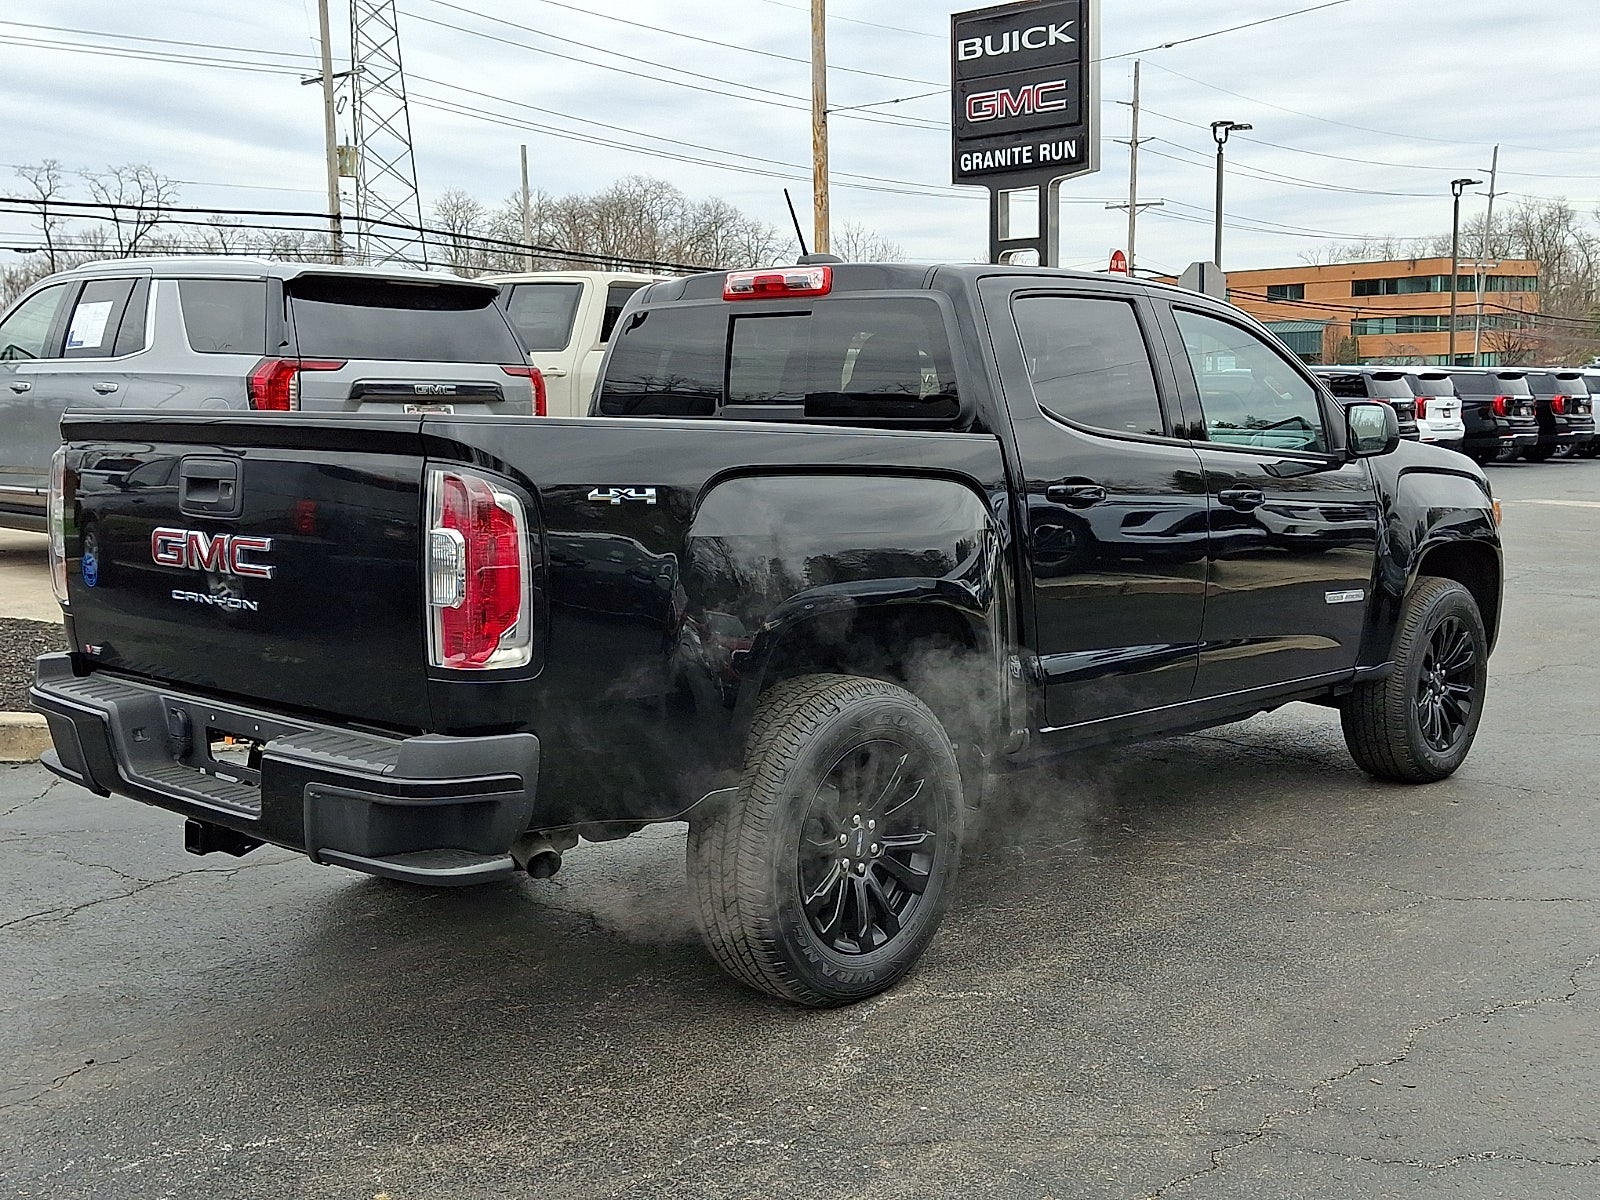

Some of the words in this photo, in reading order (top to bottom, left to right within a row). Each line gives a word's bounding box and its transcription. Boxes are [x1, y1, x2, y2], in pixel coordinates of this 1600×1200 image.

[957, 20, 1076, 61] BUICK
[966, 79, 1068, 122] GMC
[960, 145, 1033, 171] GRANITE
[1039, 139, 1077, 162] RUN
[414, 384, 457, 395] GMC
[151, 526, 277, 580] GMC
[171, 589, 260, 611] CANYON
